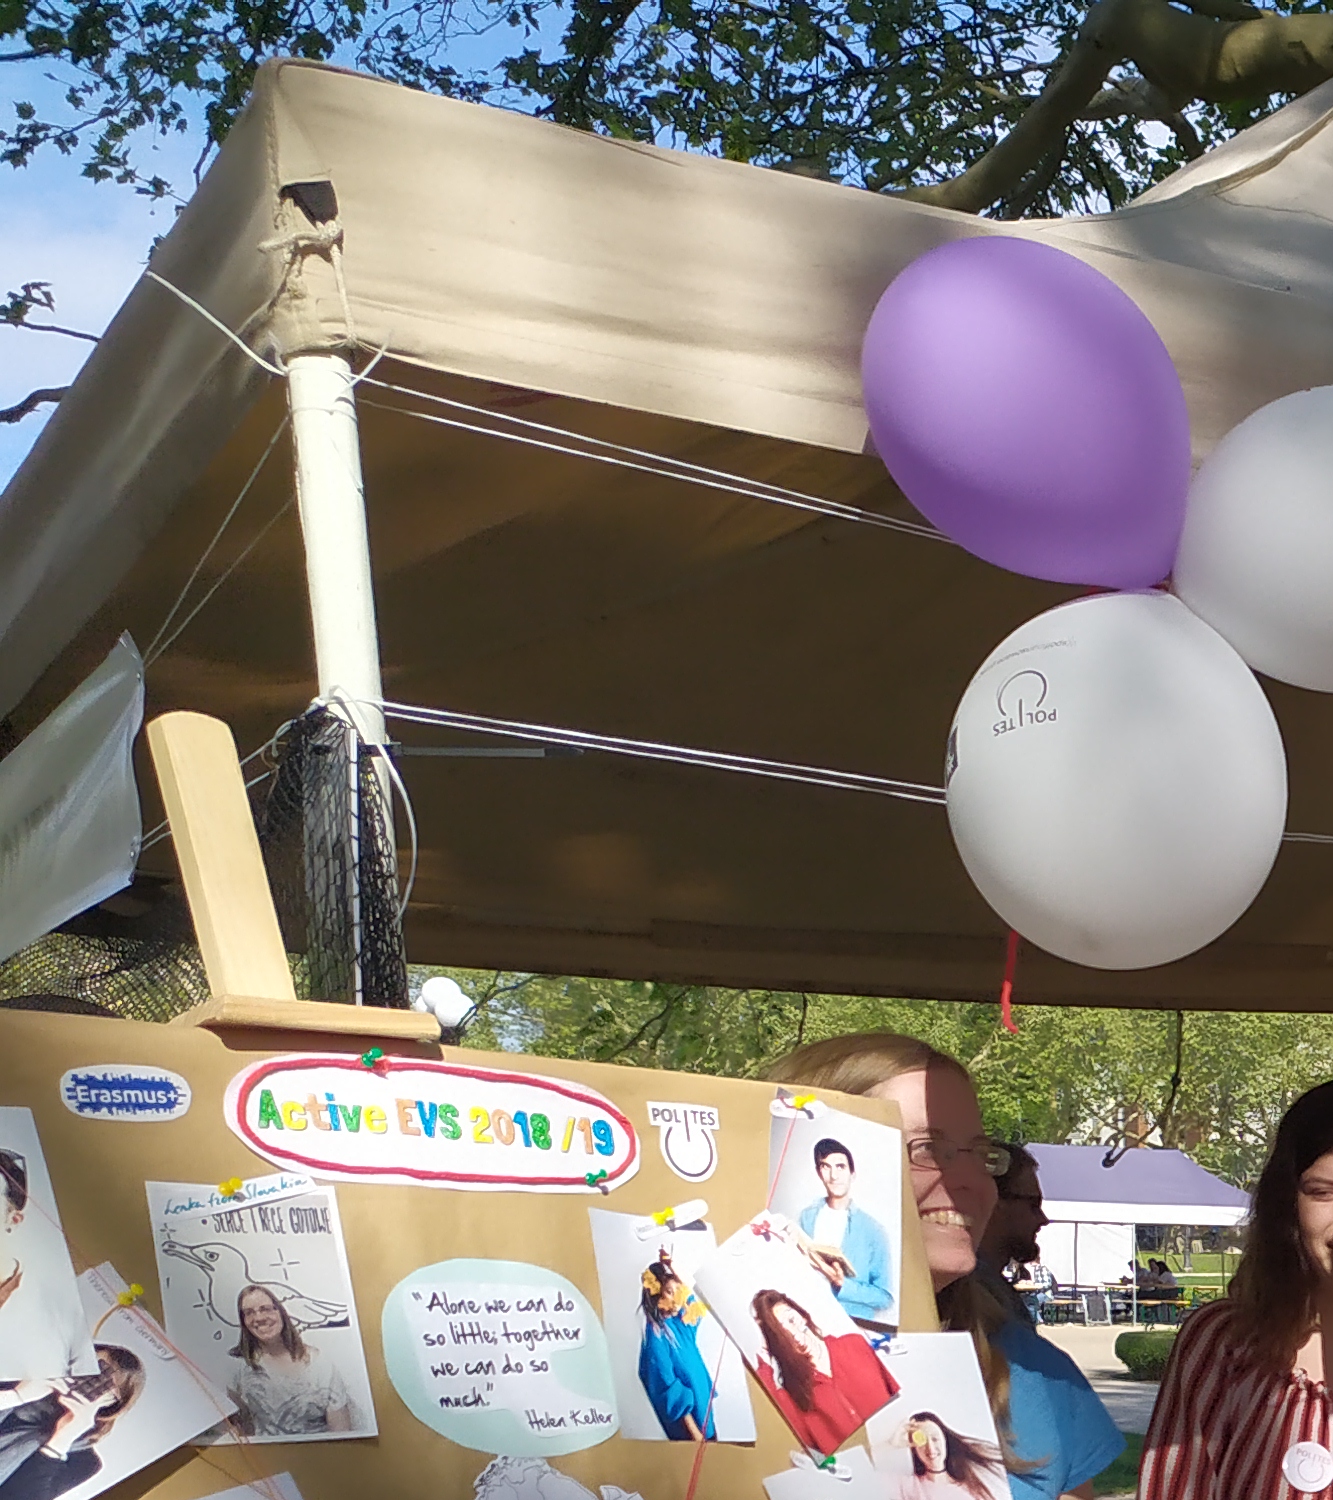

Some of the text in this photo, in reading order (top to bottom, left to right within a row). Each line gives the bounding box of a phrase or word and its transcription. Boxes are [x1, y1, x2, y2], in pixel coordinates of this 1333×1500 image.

[993, 703, 1056, 736] POLITES
[76, 1085, 177, 1104] Erasmus+
[258, 1089, 387, 1133] Active
[394, 1098, 462, 1140] EVS
[469, 1106, 552, 1150] 2018
[652, 1107, 716, 1135] POLITES
[245, 1177, 308, 1200] Slovakia
[485, 1300, 510, 1314] we
[516, 1298, 547, 1313] can
[554, 1291, 574, 1312] do
[423, 1332, 446, 1346] so
[501, 1320, 581, 1351] together
[430, 1353, 549, 1378] we can do so
[525, 1408, 613, 1431] Helen Keller
